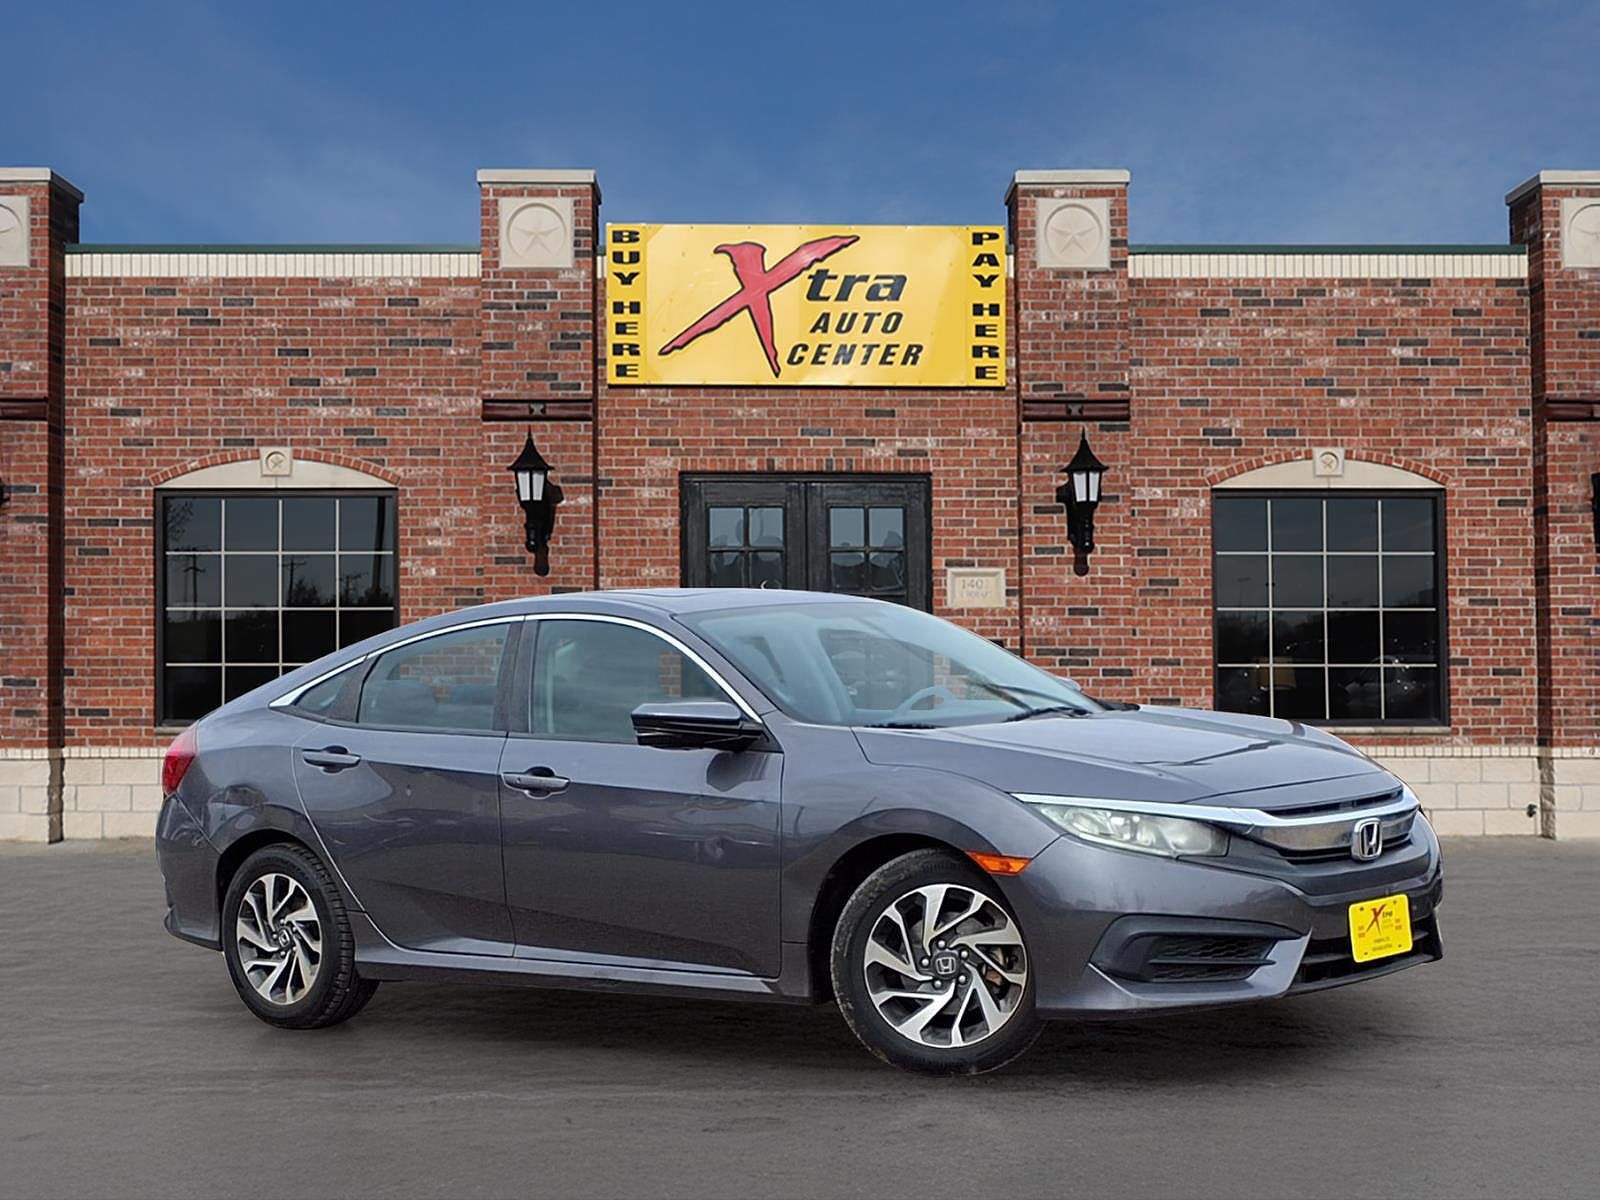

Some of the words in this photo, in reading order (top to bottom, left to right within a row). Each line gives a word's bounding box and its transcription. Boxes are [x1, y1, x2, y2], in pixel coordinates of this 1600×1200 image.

[612, 230, 640, 285] BUY
[972, 232, 1000, 288] PAY
[658, 235, 907, 378] Xtra
[810, 311, 904, 335] AUTO
[612, 301, 641, 378] HERE
[786, 343, 924, 366] CENTER
[972, 303, 1000, 380] HERE
